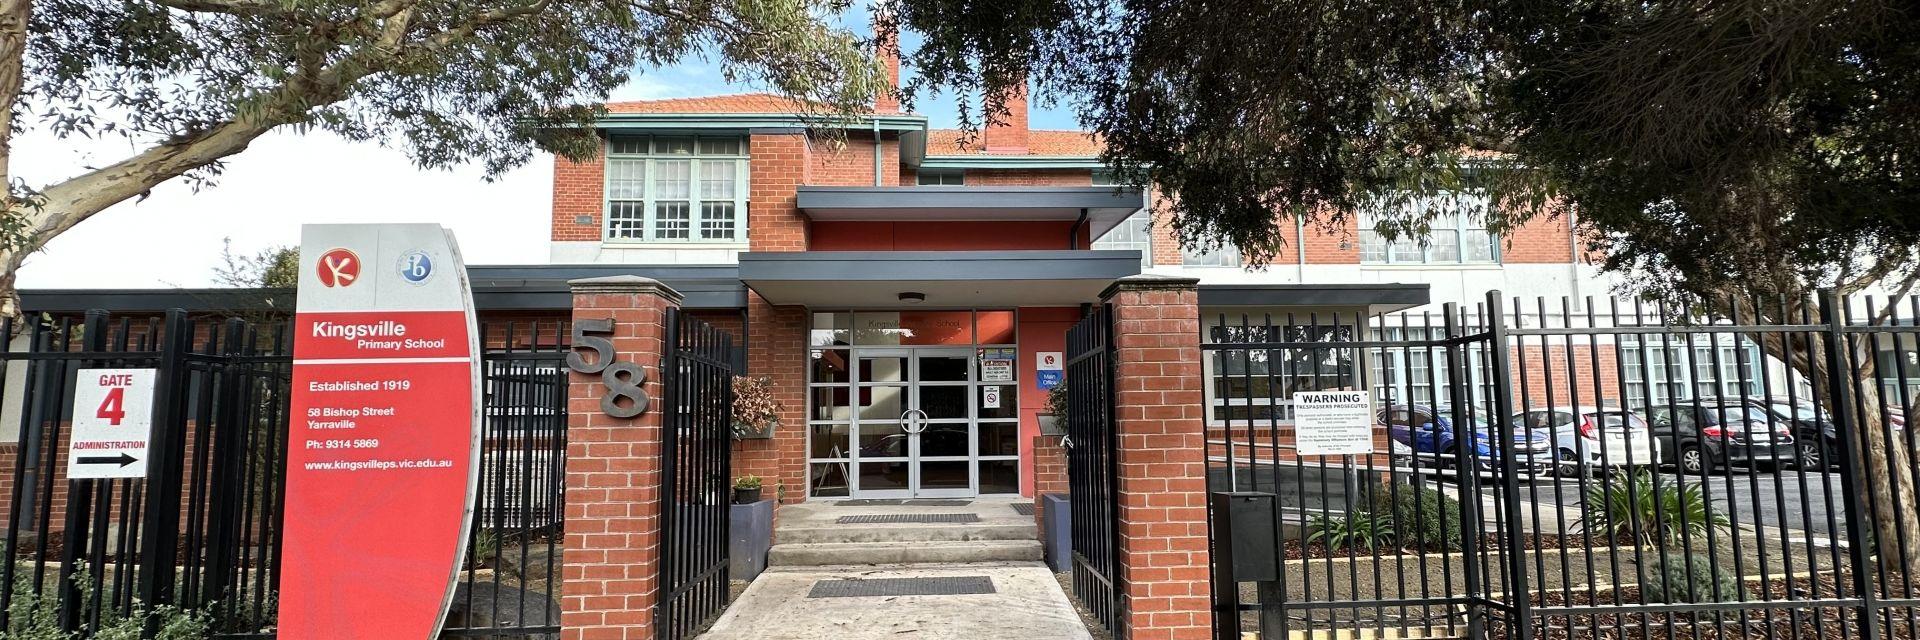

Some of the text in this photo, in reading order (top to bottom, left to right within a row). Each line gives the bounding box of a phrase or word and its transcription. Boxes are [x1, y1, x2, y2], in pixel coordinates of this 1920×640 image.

[312, 321, 406, 339] Kingsville
[357, 339, 444, 351] Primary School
[565, 317, 650, 420] 58
[99, 374, 132, 386] GATE
[309, 380, 410, 392] Established 1919
[1302, 394, 1360, 403] WARNING
[96, 388, 125, 425] 4
[307, 406, 395, 418] 58 Bishop Street
[307, 420, 356, 430] Yarraville
[73, 441, 145, 449] ADMINISTRATION
[306, 439, 379, 449] Ph: 9314 5869
[305, 460, 452, 471] www.kingsvilleps.vic.edu.au
